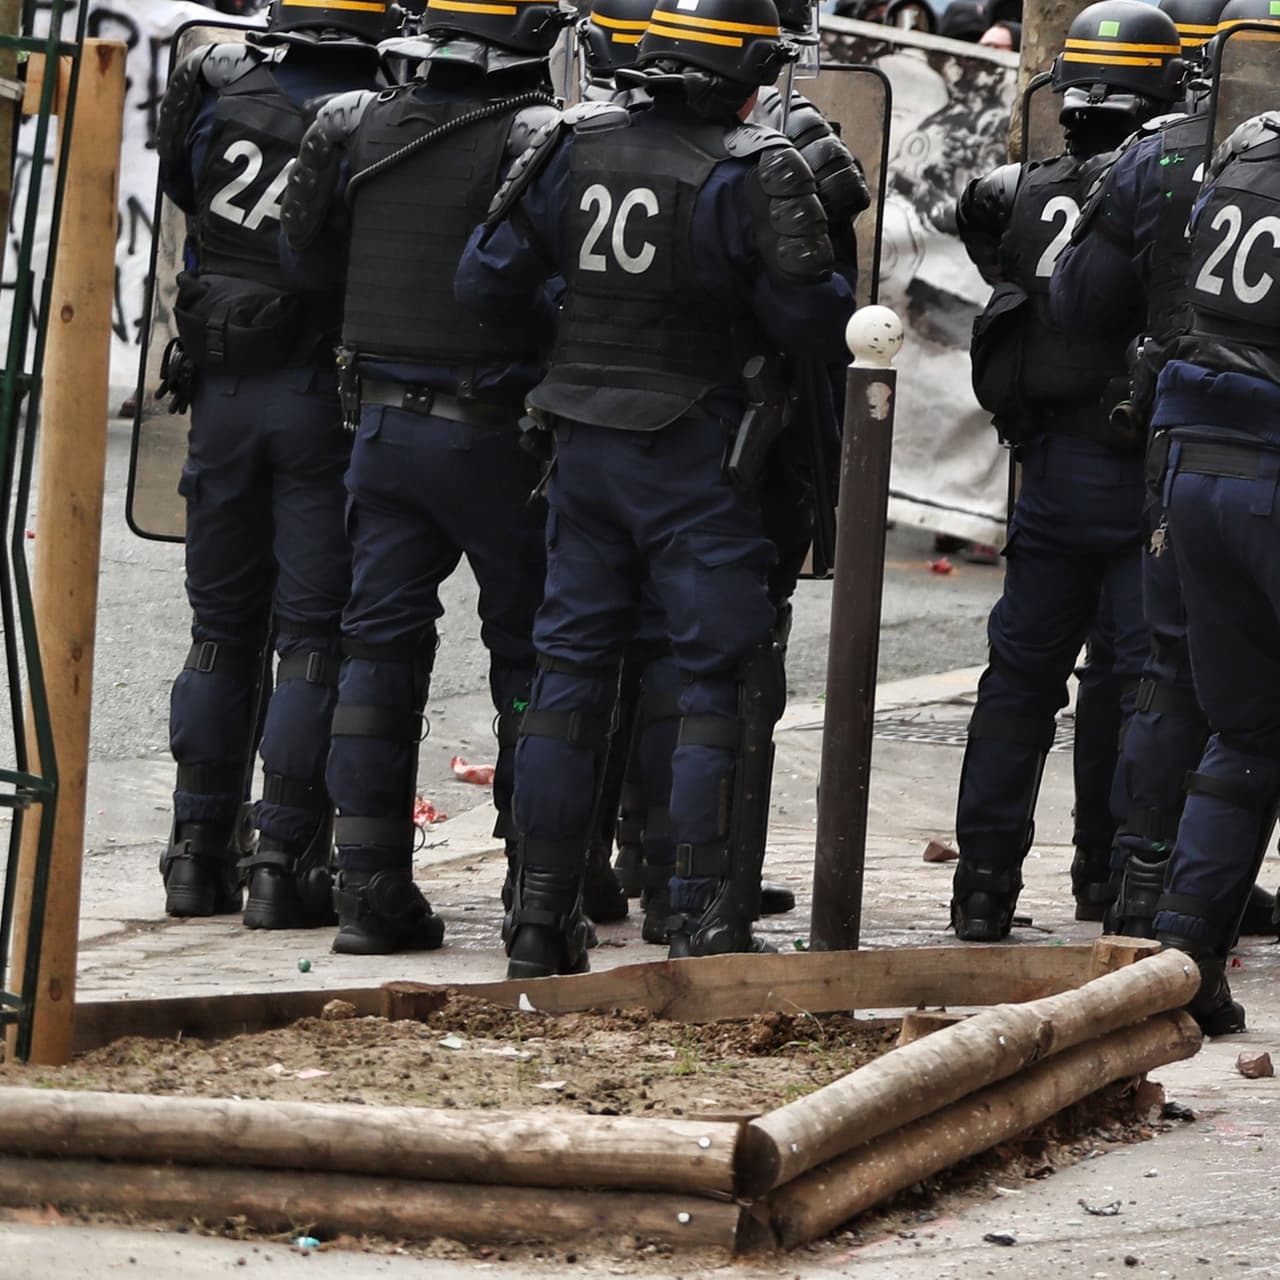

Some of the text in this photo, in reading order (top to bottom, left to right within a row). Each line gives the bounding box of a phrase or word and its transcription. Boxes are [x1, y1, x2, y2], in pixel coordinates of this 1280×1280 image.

[209, 139, 297, 231] 2A
[579, 183, 660, 274] 2C
[1035, 195, 1081, 278] 2
